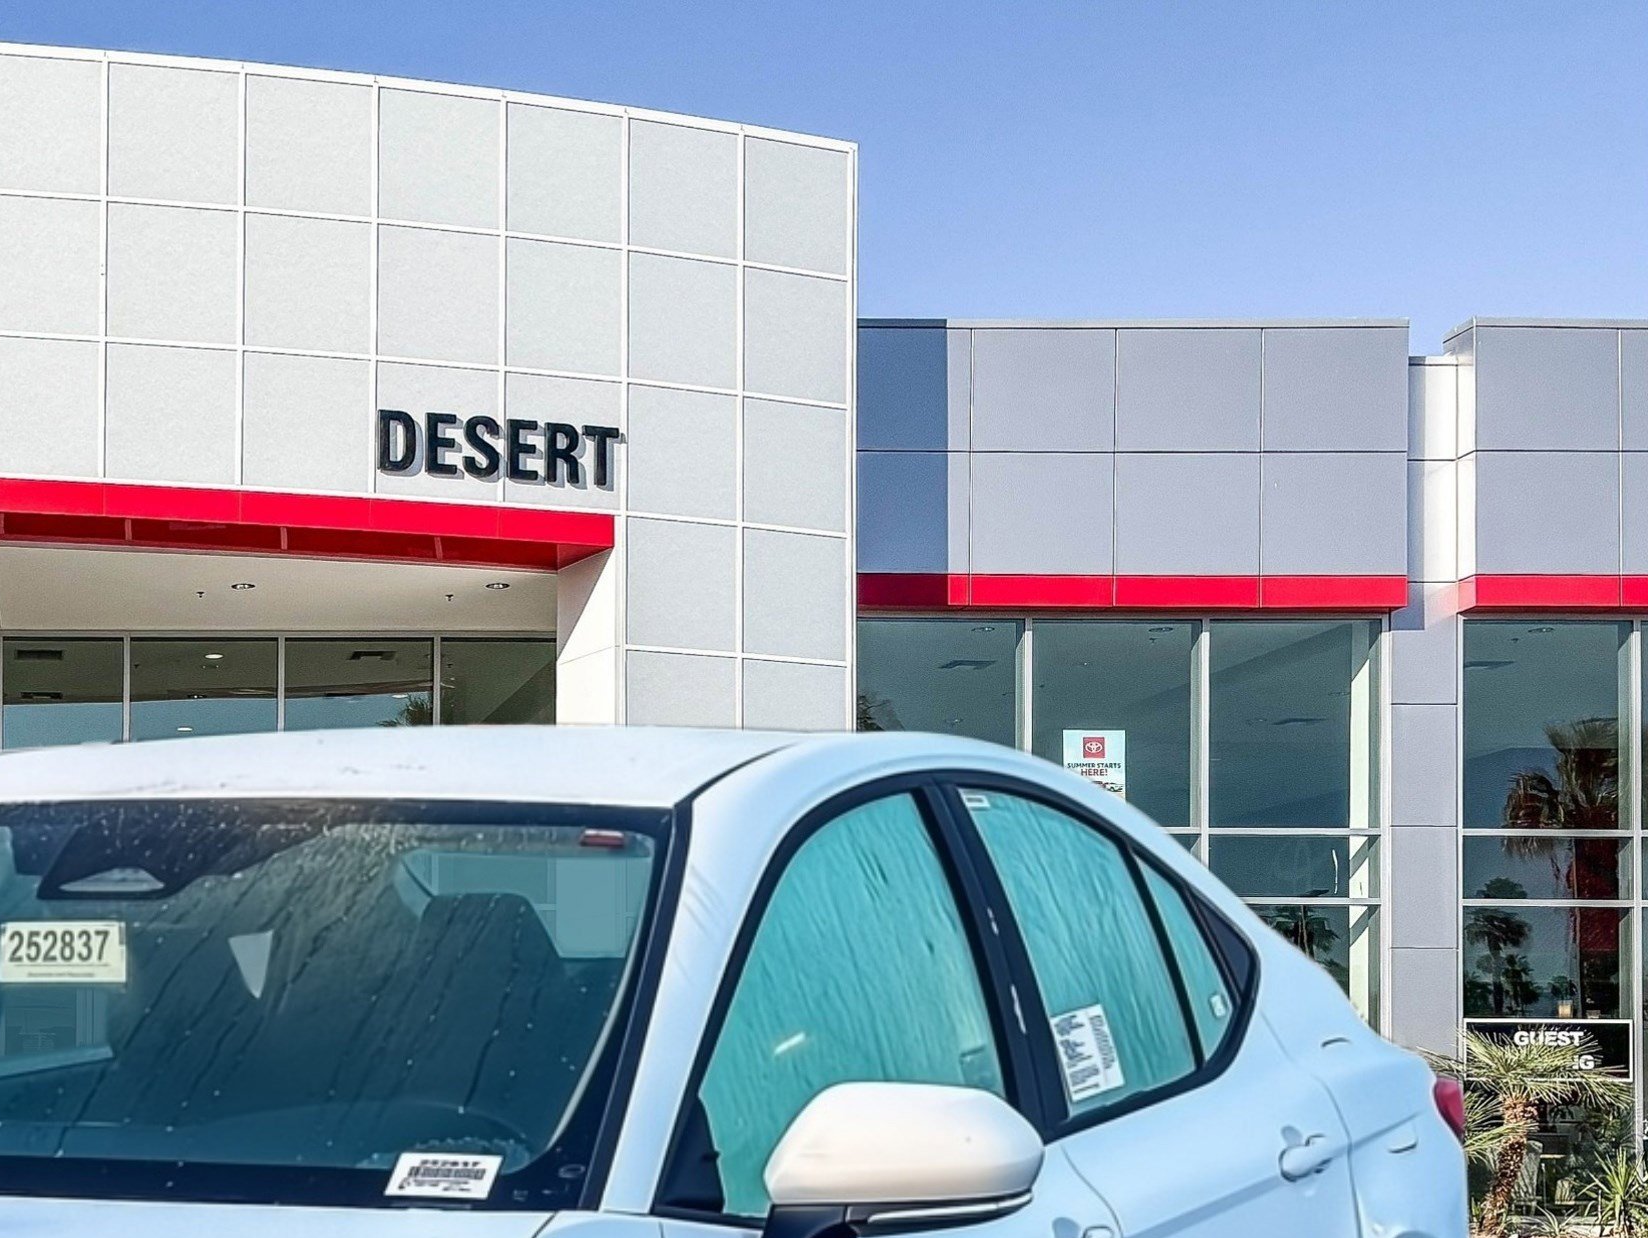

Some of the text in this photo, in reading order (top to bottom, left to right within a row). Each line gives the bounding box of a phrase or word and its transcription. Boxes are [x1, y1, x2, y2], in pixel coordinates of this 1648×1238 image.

[377, 409, 620, 487] DESERT
[8, 930, 110, 963] 252837
[1513, 1031, 1584, 1046] GUEST
